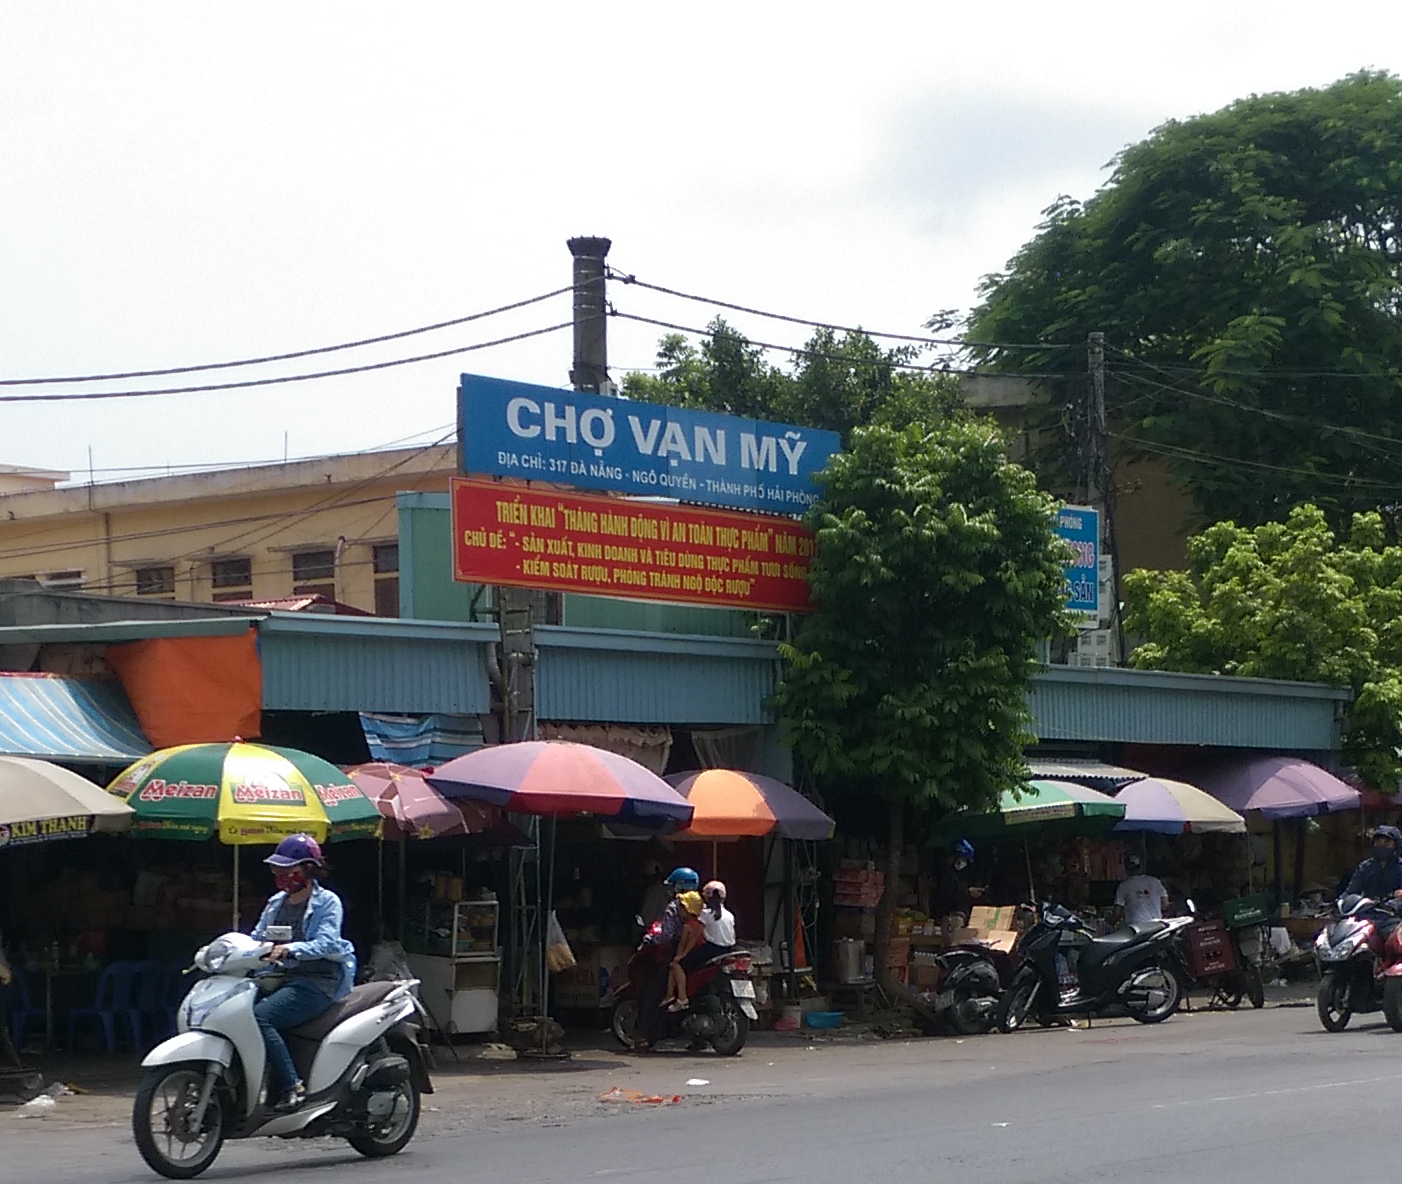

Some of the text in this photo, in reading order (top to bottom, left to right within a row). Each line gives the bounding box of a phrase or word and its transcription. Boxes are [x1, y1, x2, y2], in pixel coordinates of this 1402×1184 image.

[507, 397, 808, 476] CHỢ VẠN MỸ
[498, 452, 519, 468] ĐỊA
[549, 458, 567, 473] 317
[570, 460, 588, 476] ĐÀ
[632, 469, 657, 485] NGÔ
[705, 479, 741, 496] THÀNH
[743, 483, 765, 499] PHỐ
[767, 485, 784, 503] HẢI
[496, 495, 528, 526] TRIỂN
[530, 505, 556, 529] KHAI
[600, 509, 629, 537] HÀNH
[630, 513, 658, 543] ĐỘNG
[660, 516, 670, 541] VÌ
[672, 522, 687, 543] AN
[688, 521, 714, 546] TOÀN
[716, 526, 739, 552] THỰC
[464, 526, 487, 548] CHỦ
[522, 531, 545, 553] SẢN
[577, 542, 602, 560] KINH
[604, 545, 638, 563] DOANH
[640, 546, 654, 565] VÀ
[655, 548, 676, 567] TIÊU
[678, 550, 705, 570] DÙNG
[706, 556, 730, 575] THỰC
[523, 554, 550, 577] KIỂM
[552, 561, 579, 580] SOÁT
[613, 566, 647, 586] PHÒNG
[649, 570, 681, 589] TRÁNH
[683, 573, 703, 594] NGỘ
[140, 779, 218, 801] Meizan
[235, 784, 303, 802] Meizan
[314, 783, 364, 807] Meizan
[10, 821, 37, 838] KIM
[40, 816, 87, 834] THANH
